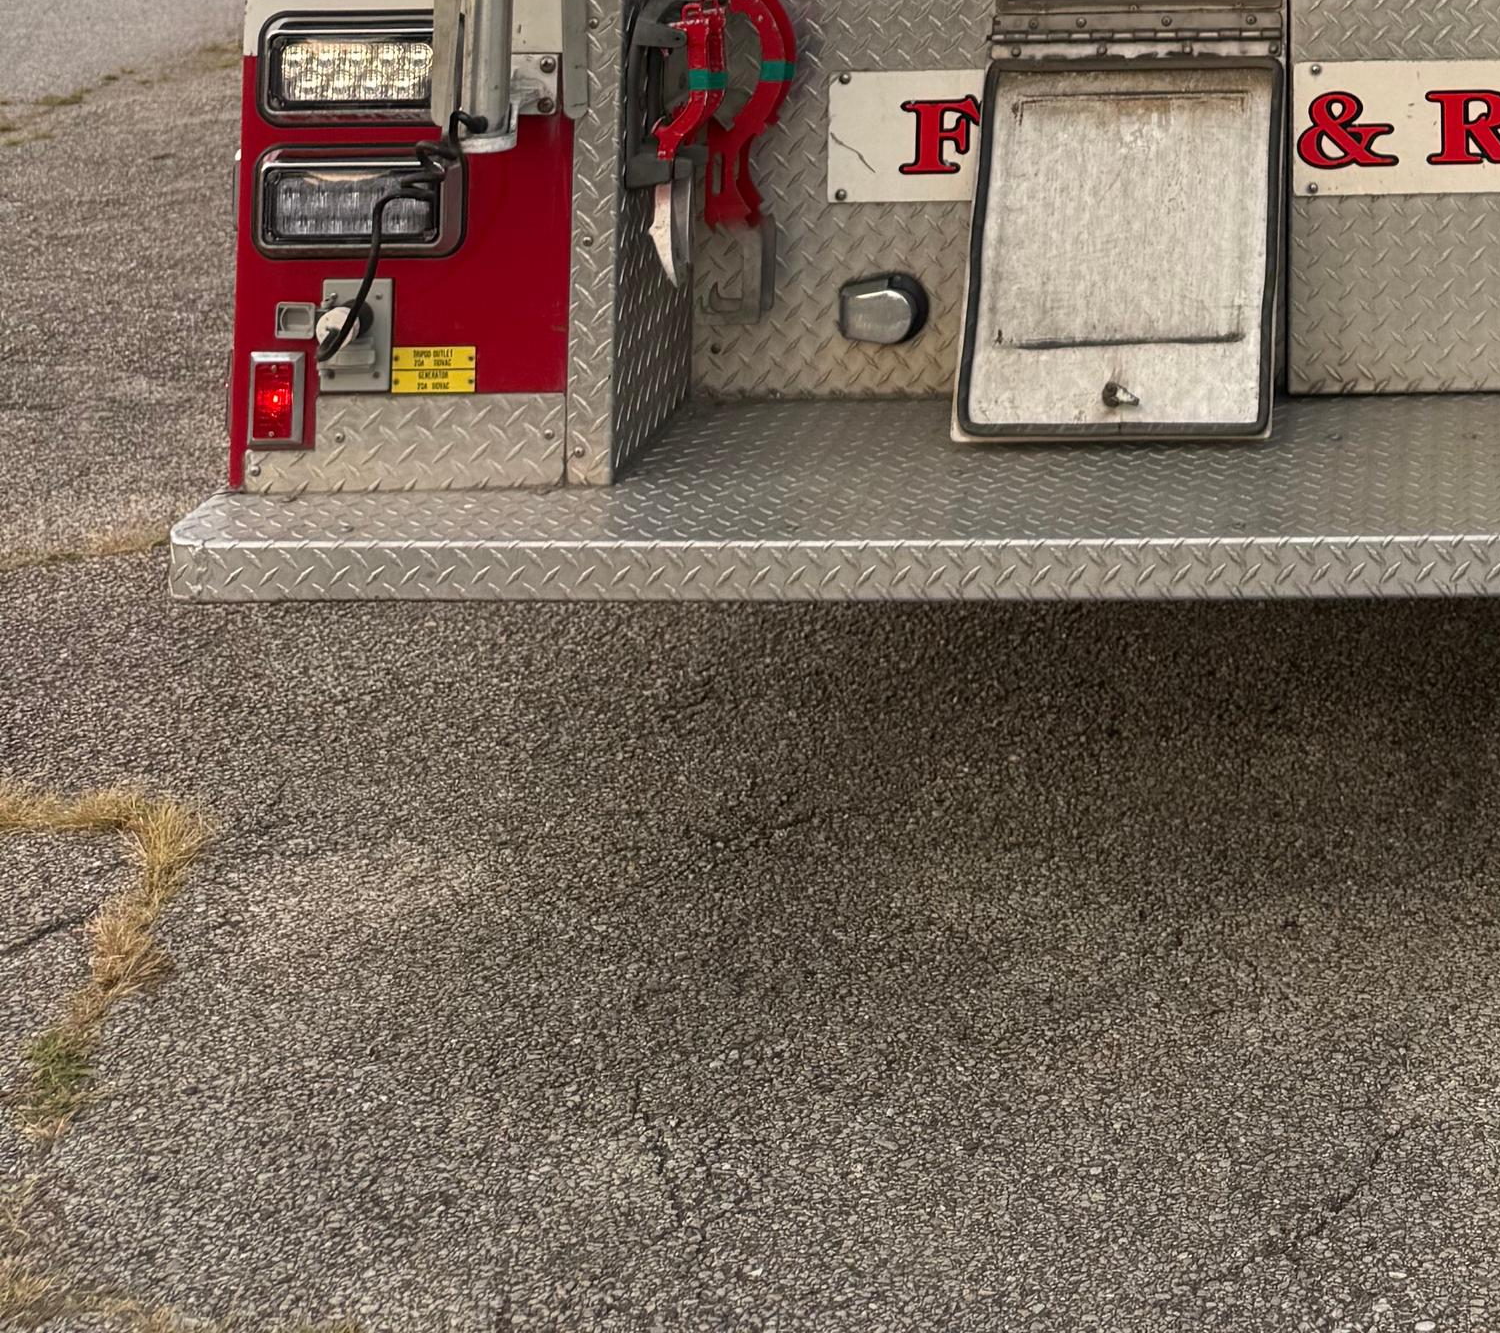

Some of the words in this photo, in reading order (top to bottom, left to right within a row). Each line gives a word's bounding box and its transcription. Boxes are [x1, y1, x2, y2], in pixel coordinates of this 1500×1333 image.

[1298, 90, 1399, 169] &
[413, 349, 432, 358] TRIPOD
[433, 349, 453, 358] OUTLET
[418, 371, 449, 380] GENERATOR
